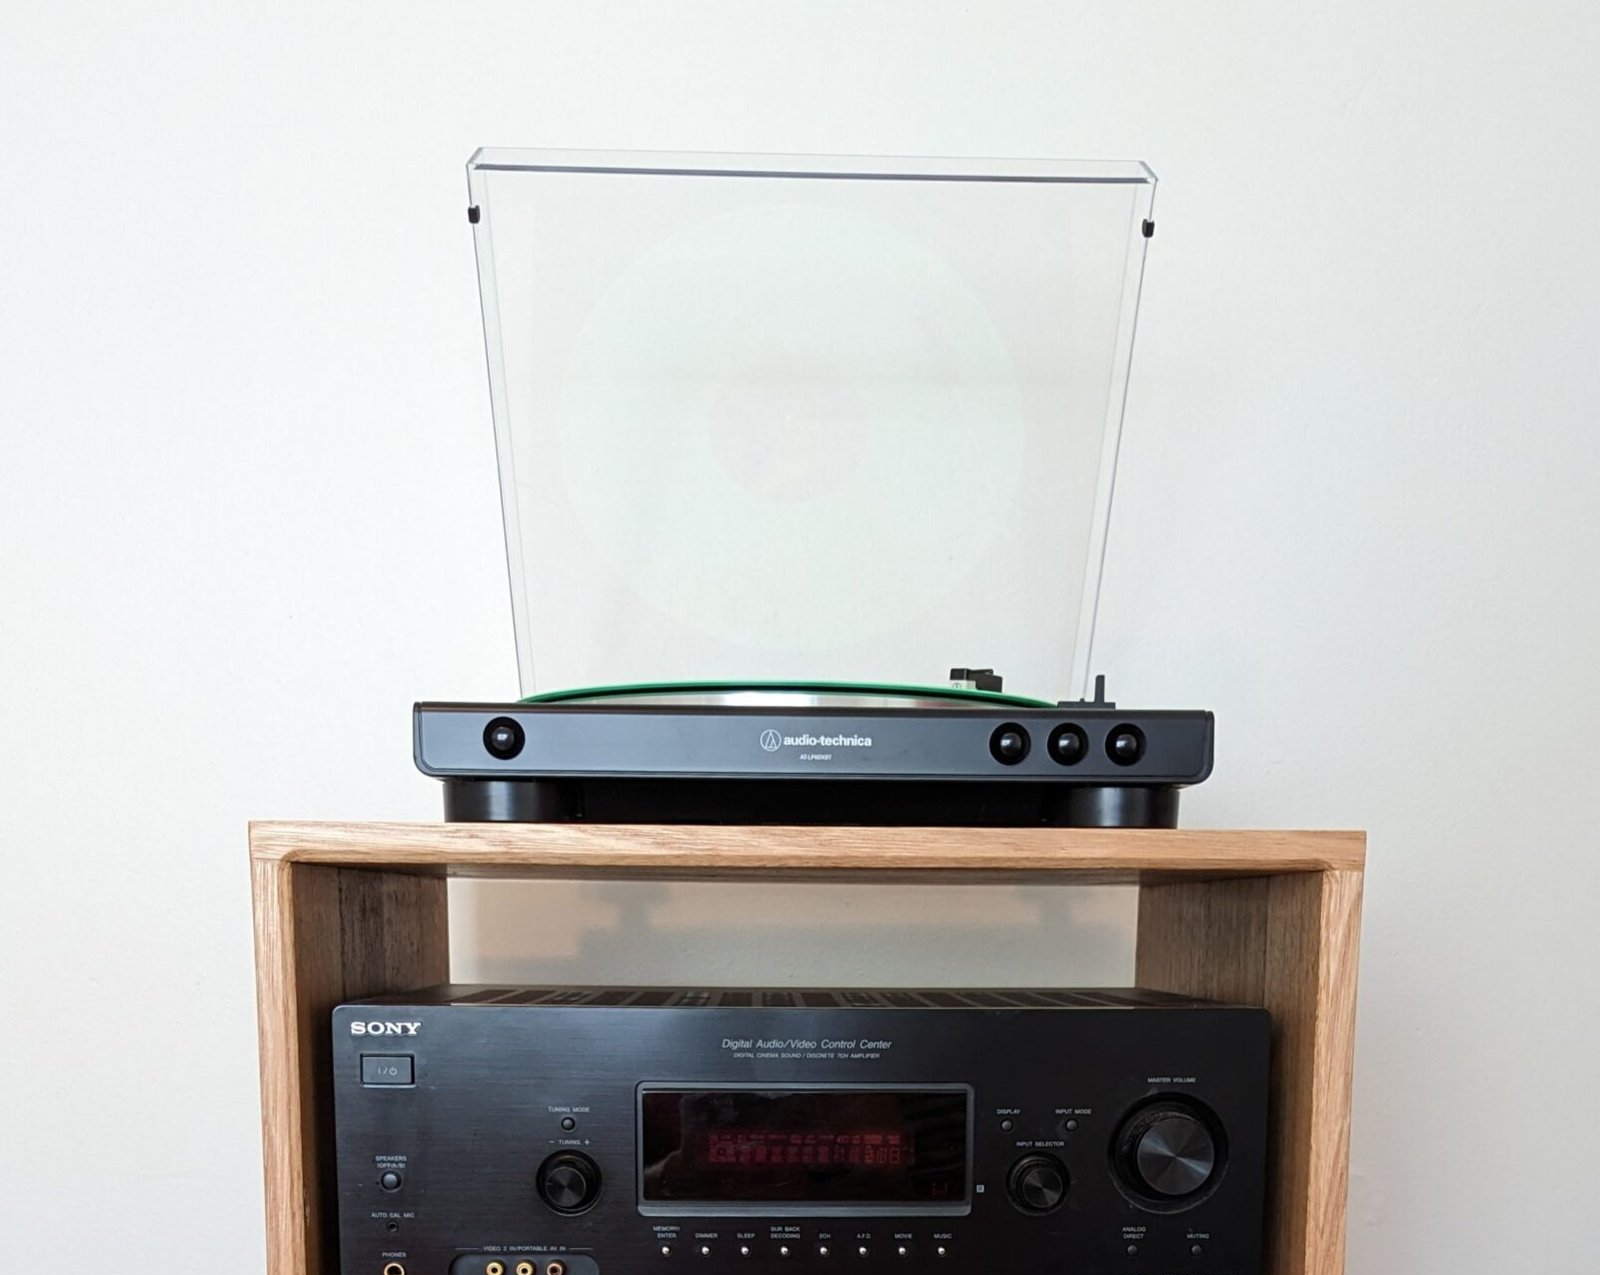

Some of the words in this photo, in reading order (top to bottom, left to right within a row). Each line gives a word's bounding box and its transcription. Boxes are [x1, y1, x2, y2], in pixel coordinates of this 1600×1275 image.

[783, 734, 873, 747] audio-technica
[350, 1021, 422, 1035] SONY
[722, 1038, 752, 1050] Digital
[755, 1038, 817, 1049] Audio/Video
[820, 1039, 856, 1049] Control
[859, 1039, 892, 1049] Center
